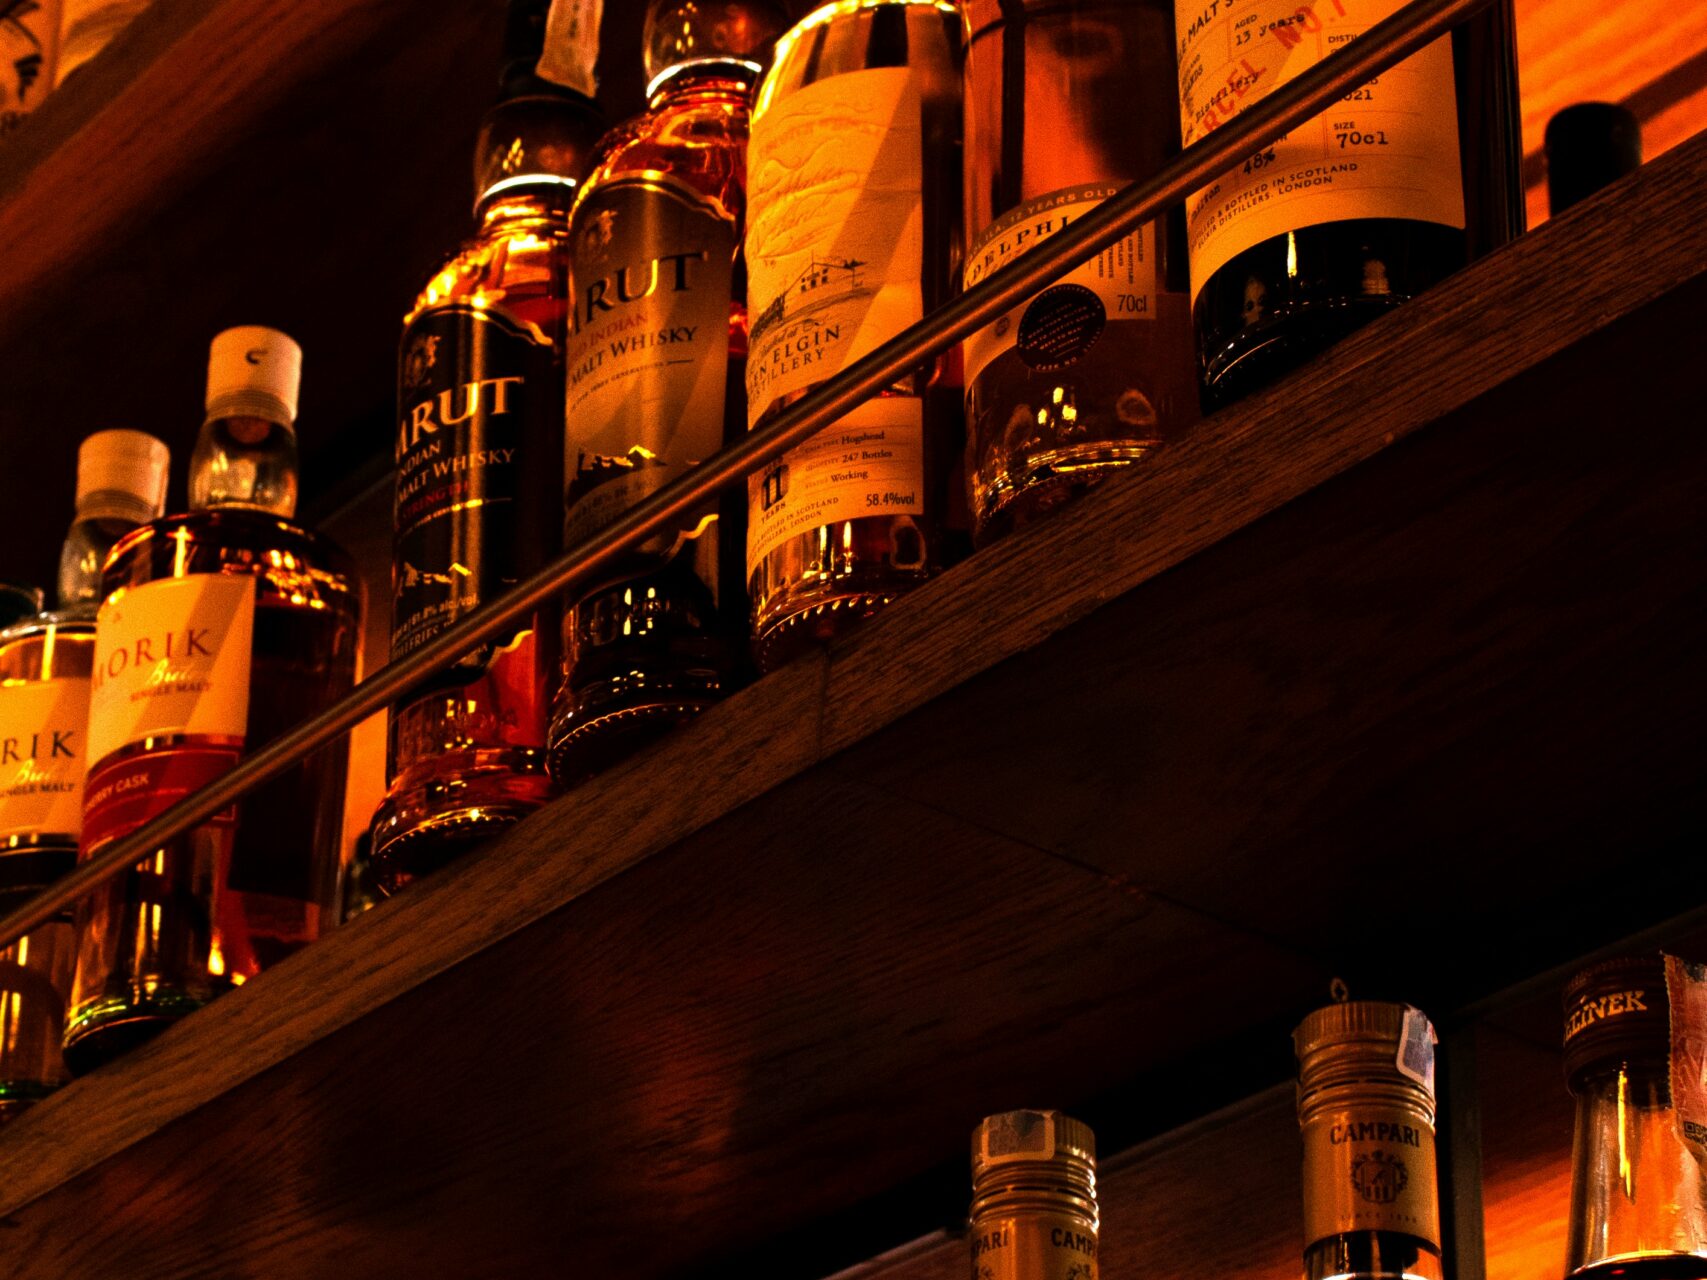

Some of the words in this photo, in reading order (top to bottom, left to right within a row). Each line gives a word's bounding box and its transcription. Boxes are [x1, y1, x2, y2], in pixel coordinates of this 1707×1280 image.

[1188, 1, 1219, 43] MALT
[1235, 14, 1258, 30] AGED
[1235, 30, 1251, 46] 13
[1259, 13, 1305, 36] years
[1334, 122, 1355, 130] SIZE
[1337, 132, 1388, 148] 70cl
[1243, 148, 1276, 174] 48%
[1225, 184, 1268, 212] BOTTLED
[1290, 162, 1358, 182] SCOTLAND
[1279, 176, 1332, 194] LONDON
[1028, 193, 1077, 213] YEARS
[1084, 188, 1118, 199] OLD
[1117, 295, 1148, 312] 70cl
[610, 326, 699, 359] WHISKY
[774, 325, 841, 363] ELGIN
[841, 430, 886, 445] Hogshead
[433, 446, 516, 478] WHISKY
[842, 452, 860, 464] 247
[862, 451, 893, 461] Bottles
[831, 469, 868, 483] Working
[796, 497, 839, 516] SCOTLAND
[866, 493, 915, 506] 58.4%vol
[117, 773, 150, 793] CASK
[1330, 1122, 1420, 1148] CAMPARI
